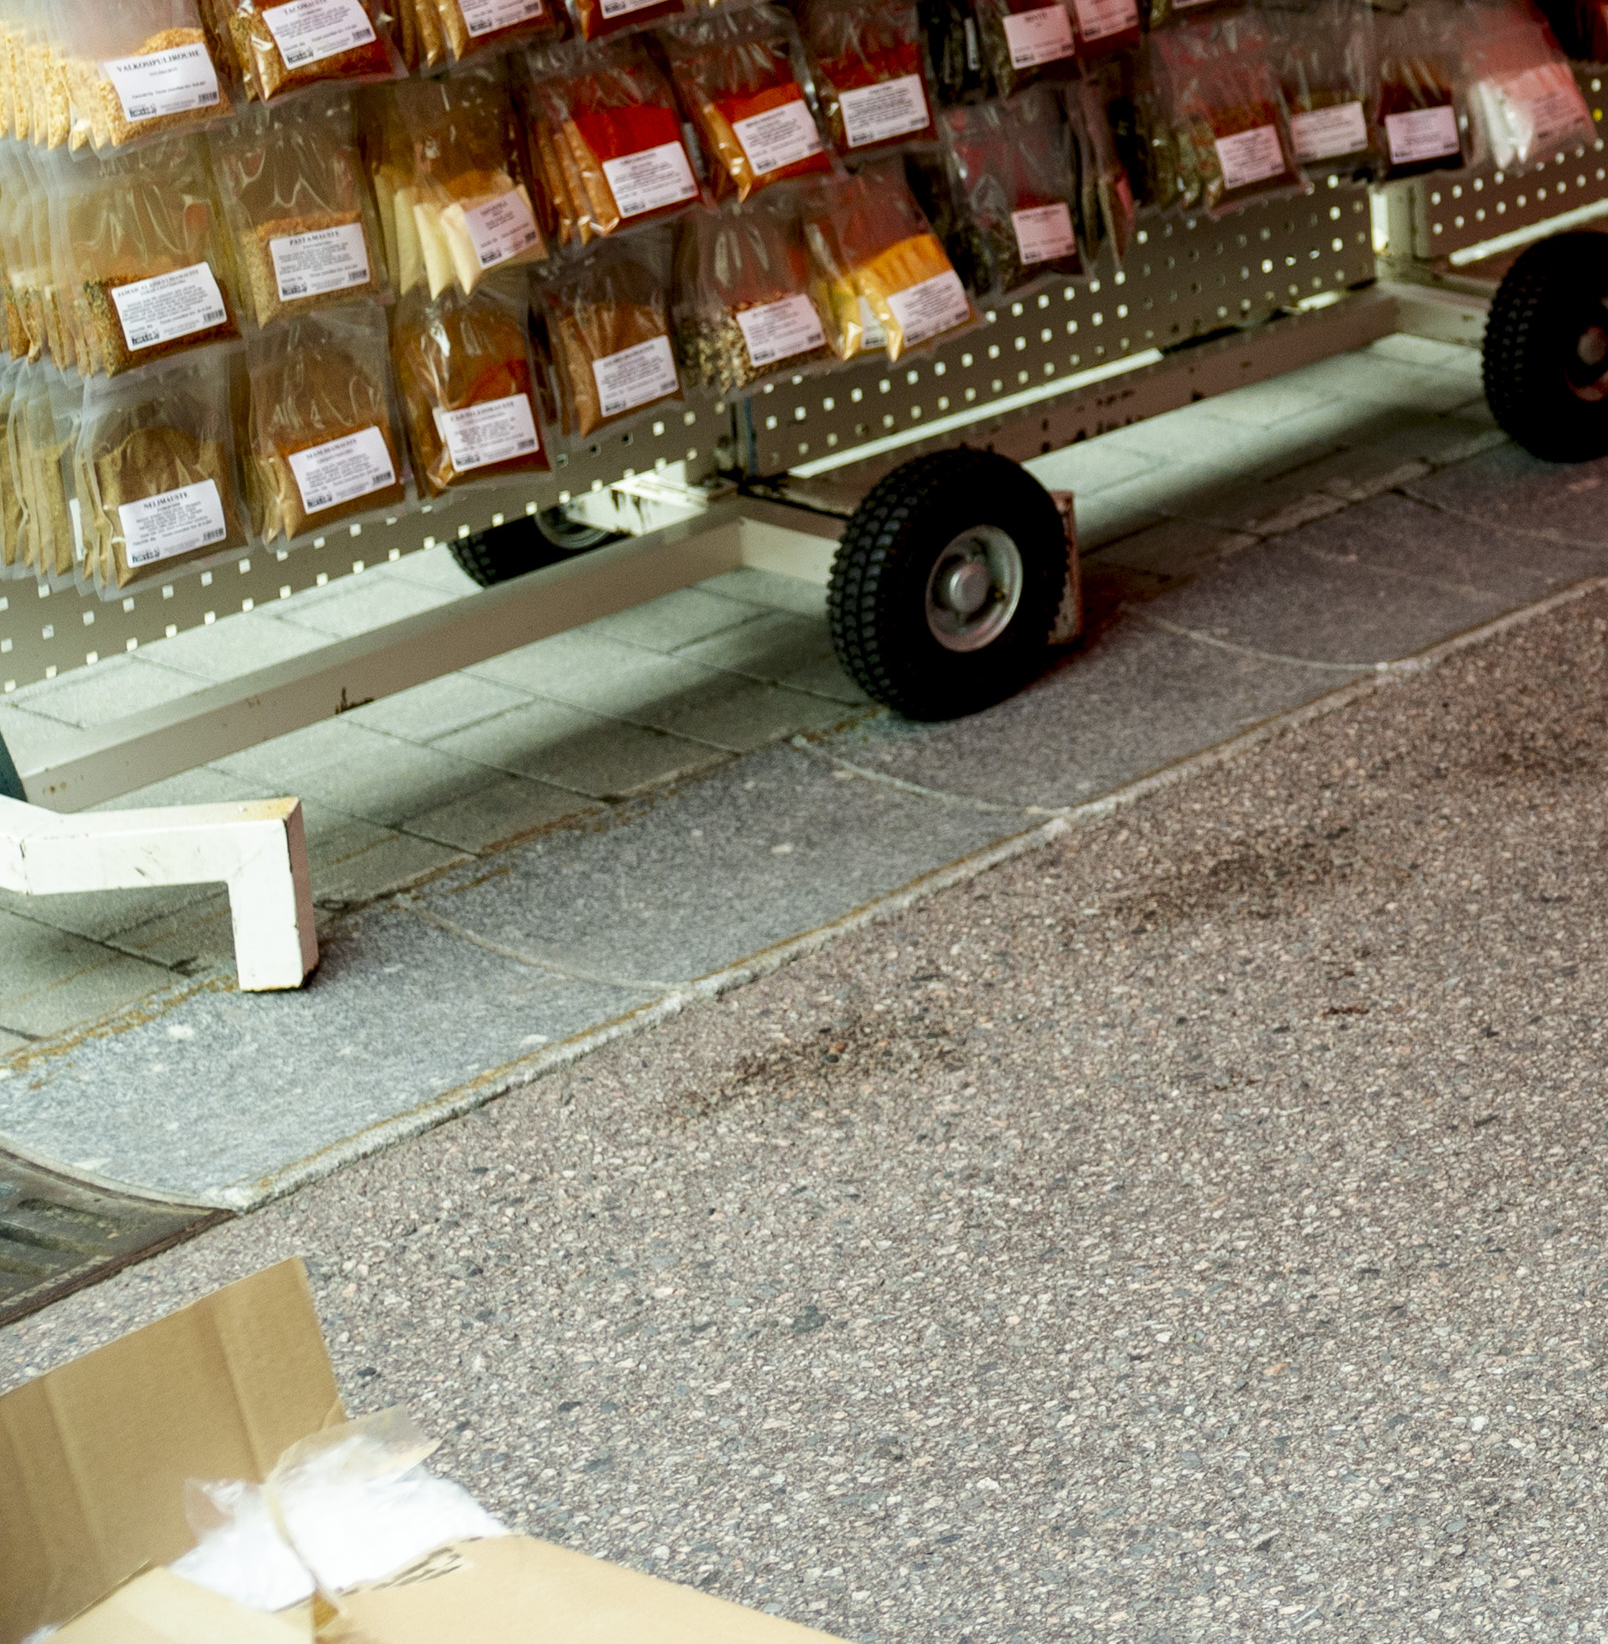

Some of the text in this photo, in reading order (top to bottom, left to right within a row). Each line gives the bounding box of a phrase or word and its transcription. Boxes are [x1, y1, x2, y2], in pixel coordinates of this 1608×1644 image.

[115, 49, 201, 72] VALKOSIPULIROUHE
[288, 230, 340, 247] PASTAMAUSTE
[142, 491, 189, 510] NELIMAUSTE
